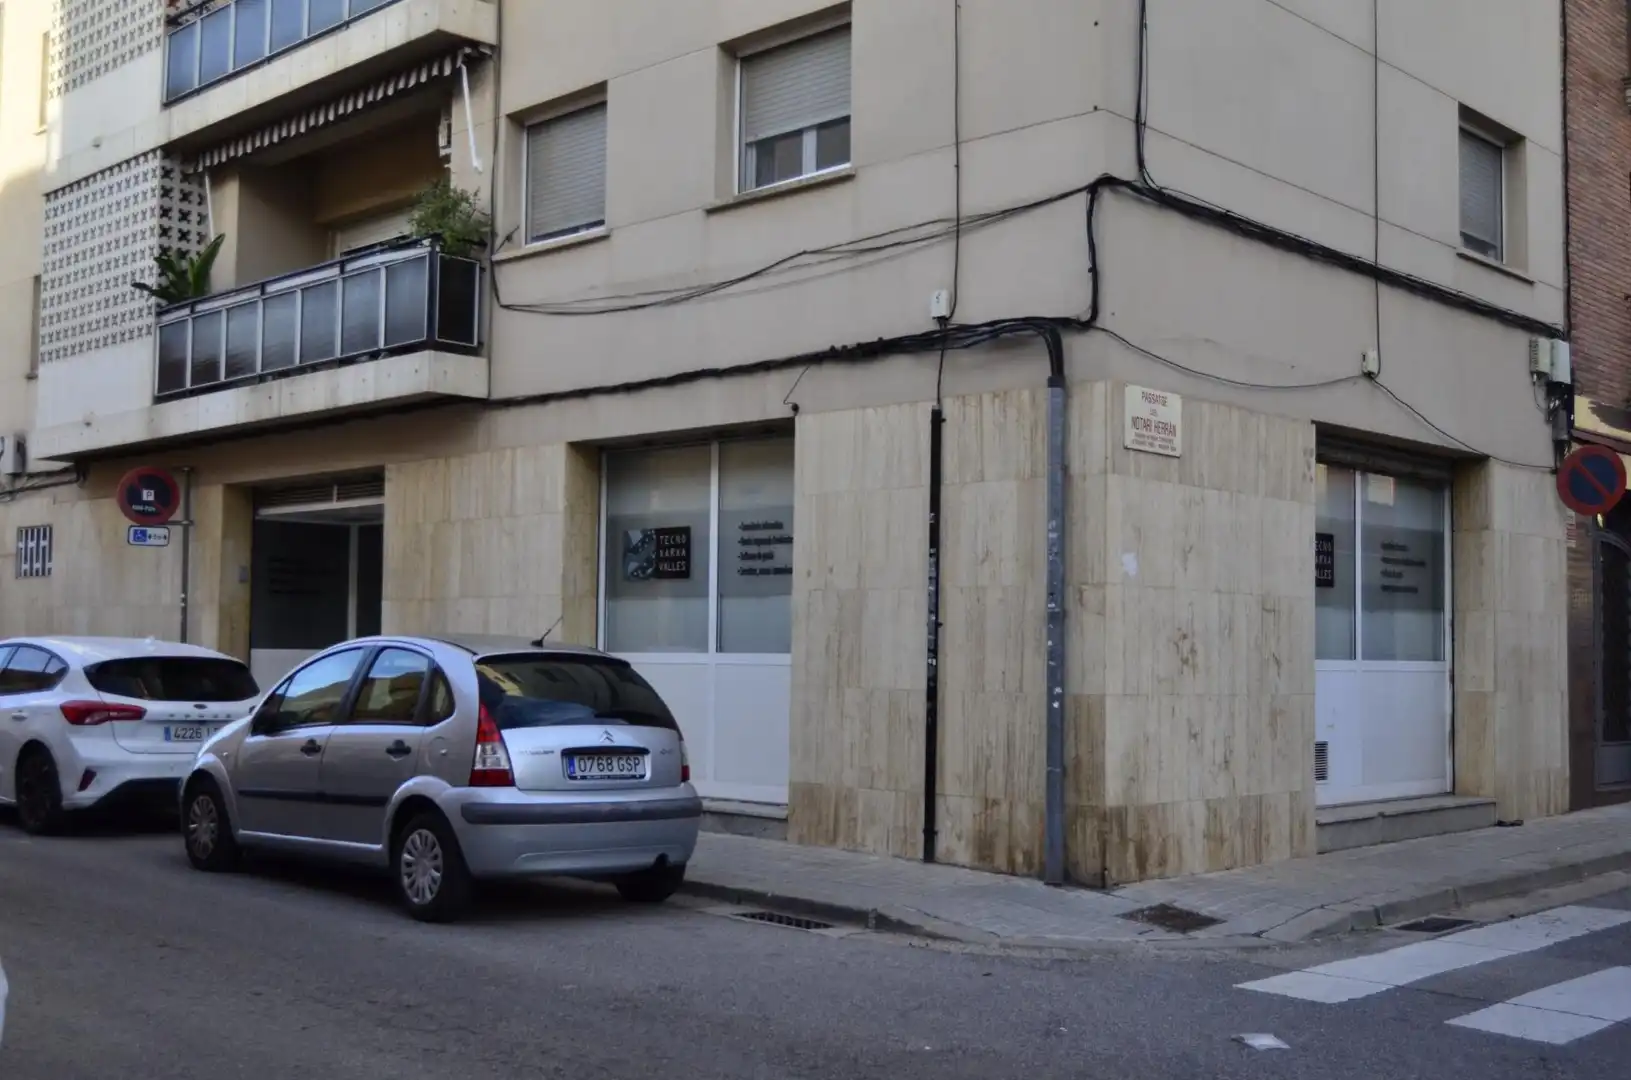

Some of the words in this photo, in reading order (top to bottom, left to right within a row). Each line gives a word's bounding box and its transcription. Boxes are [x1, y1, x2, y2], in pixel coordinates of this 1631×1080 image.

[1141, 391, 1168, 407] PASSATGE
[1131, 415, 1152, 433] NOTARI
[659, 534, 687, 545] TECNO
[1314, 540, 1332, 552] ECNO
[174, 726, 202, 739] 4226
[577, 756, 613, 773] 0768
[617, 756, 640, 773] GSP
